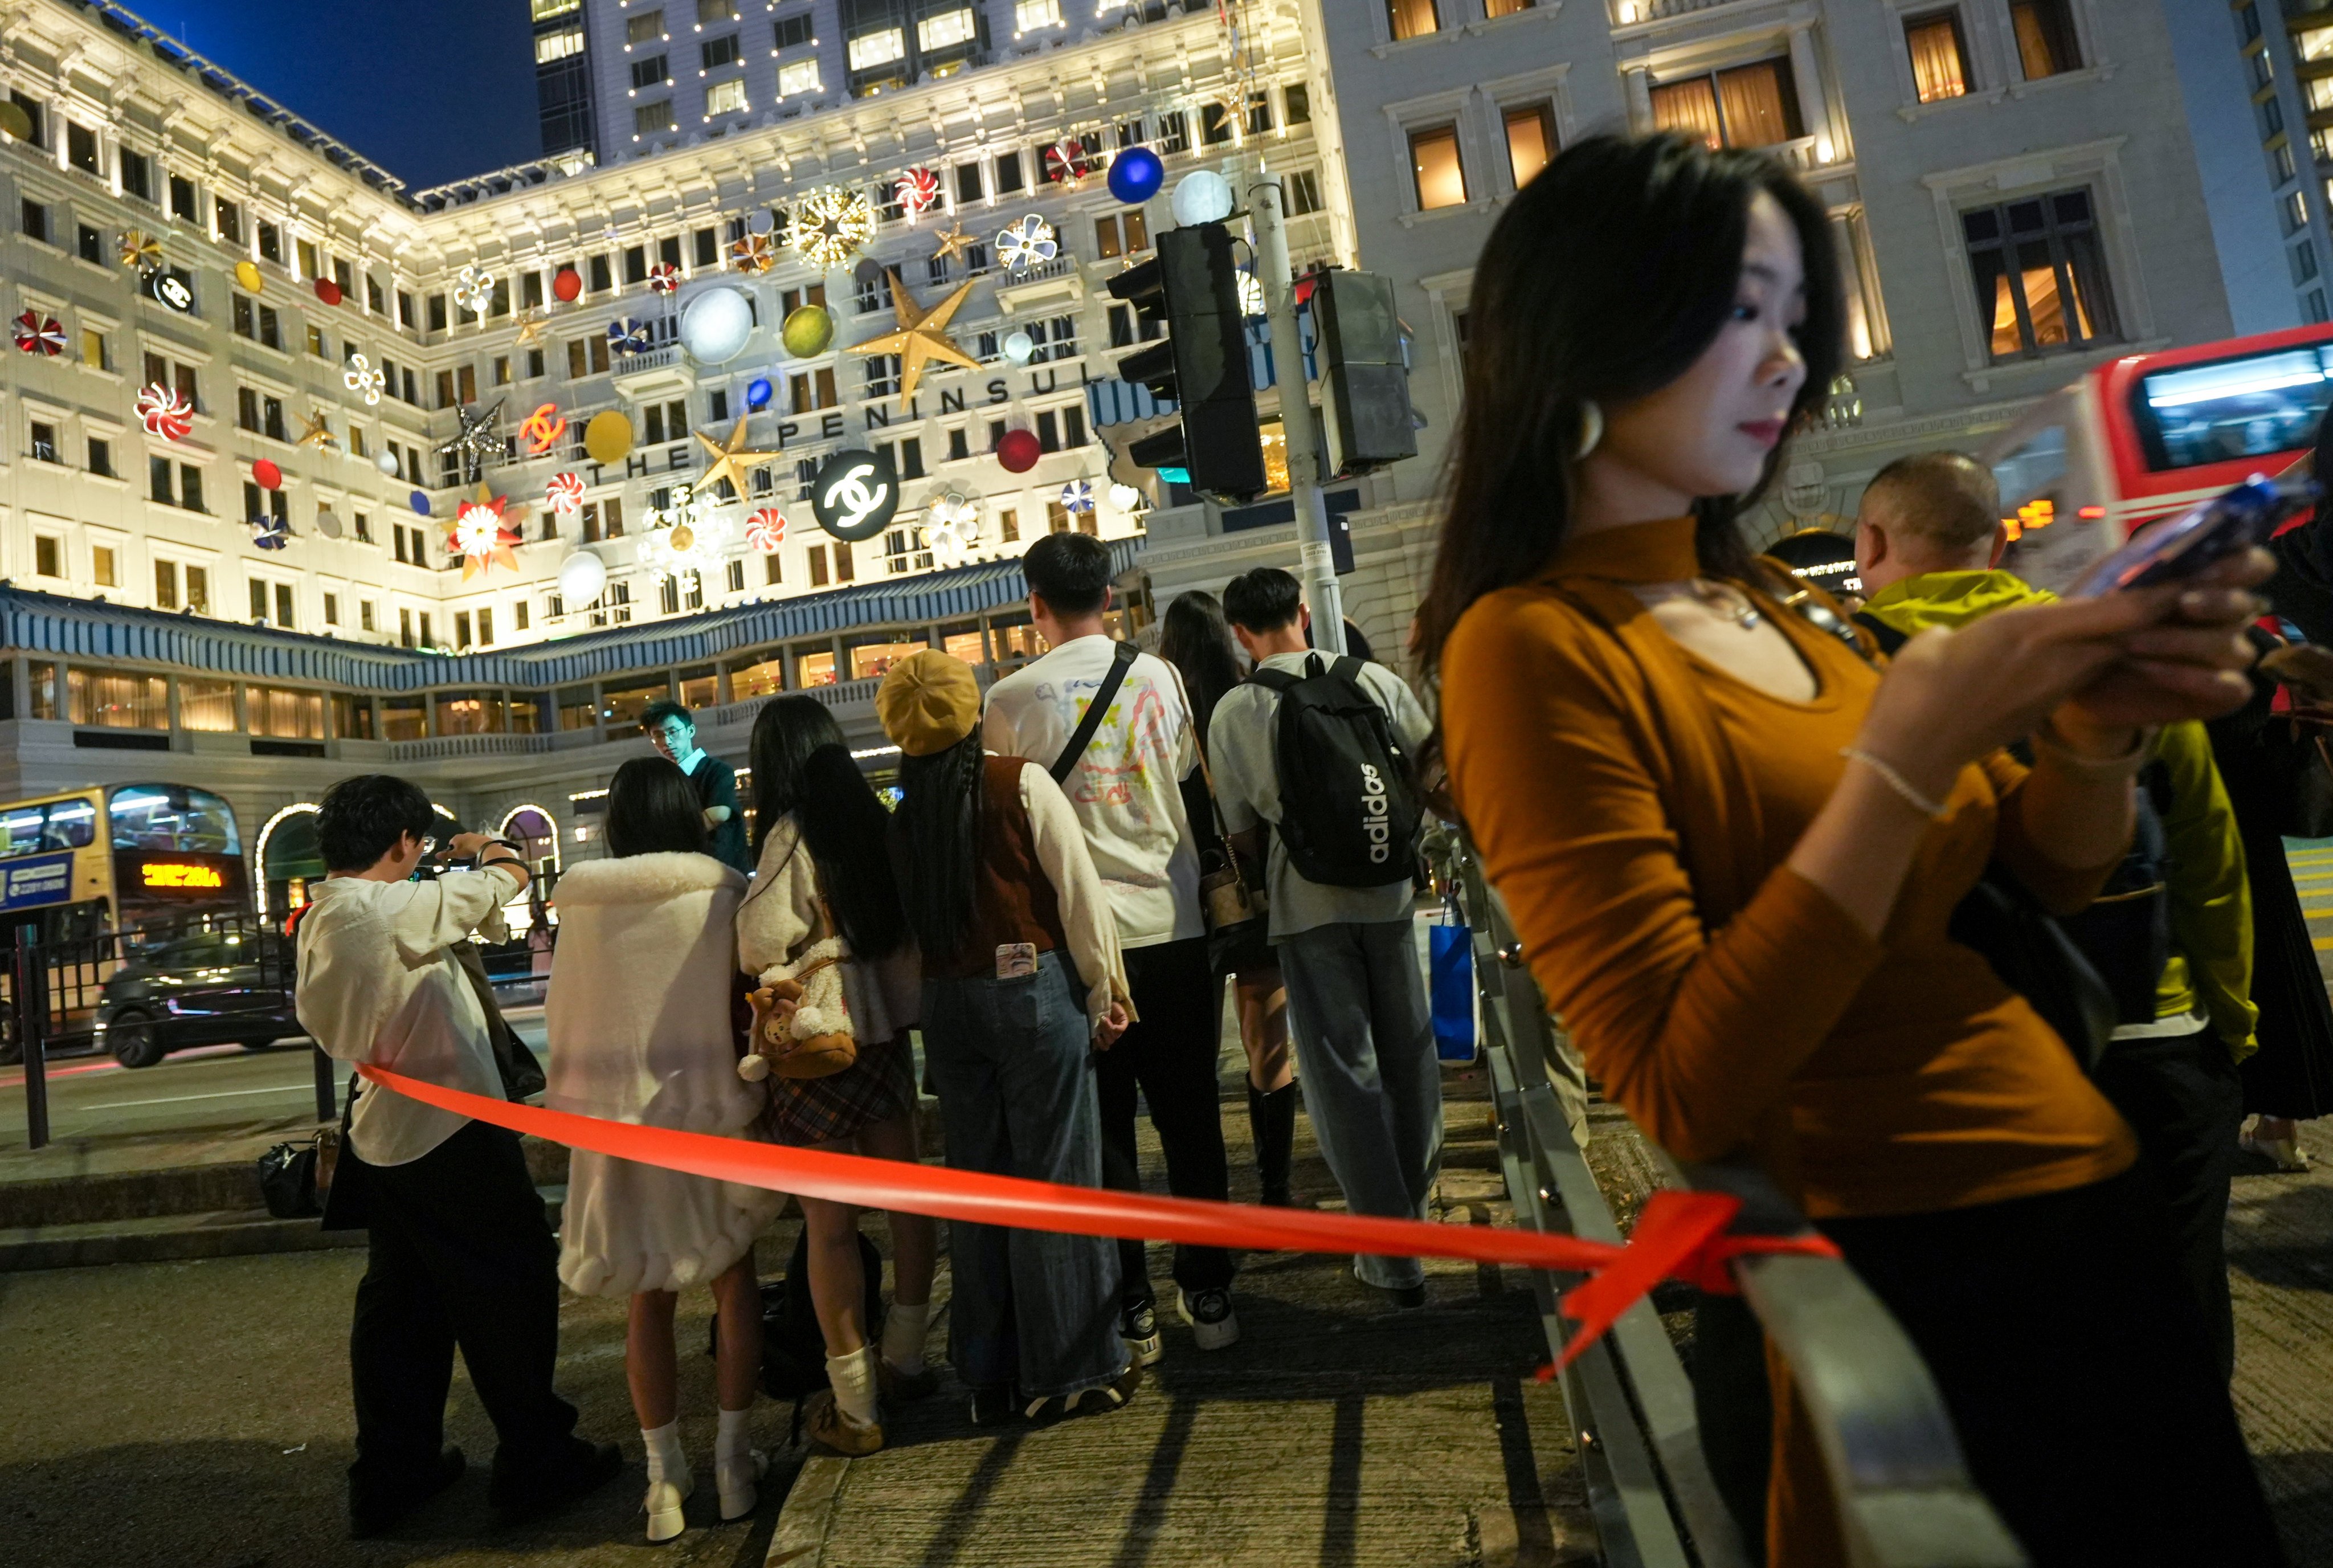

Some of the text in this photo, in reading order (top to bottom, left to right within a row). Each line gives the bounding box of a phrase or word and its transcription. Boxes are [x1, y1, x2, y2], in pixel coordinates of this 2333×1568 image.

[586, 362, 1105, 485] THE PENINSUL
[1360, 763, 1390, 864] adidas
